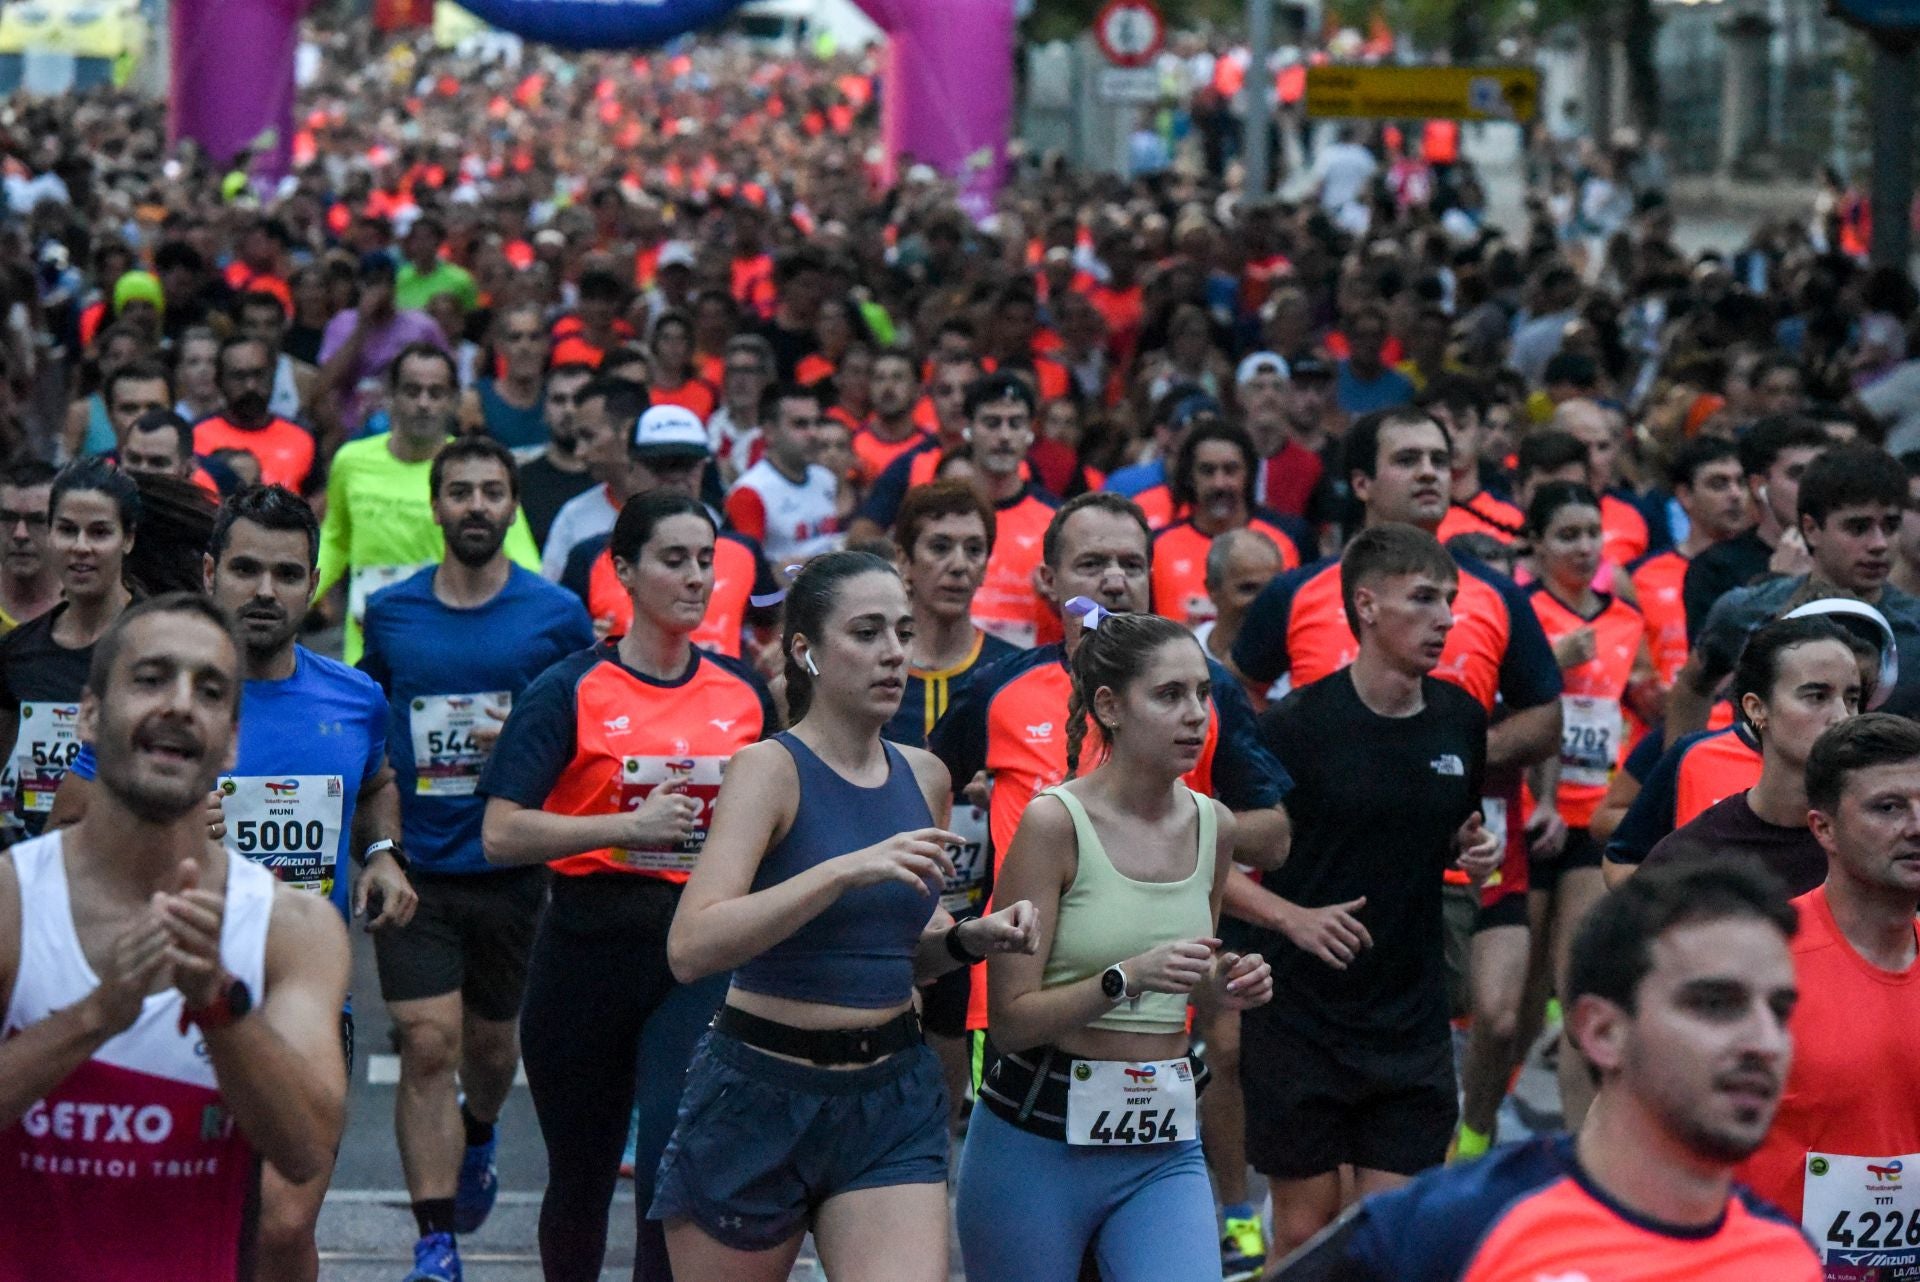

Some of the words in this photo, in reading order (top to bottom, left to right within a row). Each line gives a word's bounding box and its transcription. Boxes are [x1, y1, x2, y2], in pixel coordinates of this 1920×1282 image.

[237, 820, 324, 852] 5000
[1126, 1097, 1152, 1105] MERY
[22, 1099, 173, 1144] GETXO
[1090, 1108, 1178, 1144] 4454
[1874, 1197, 1894, 1205] TITI
